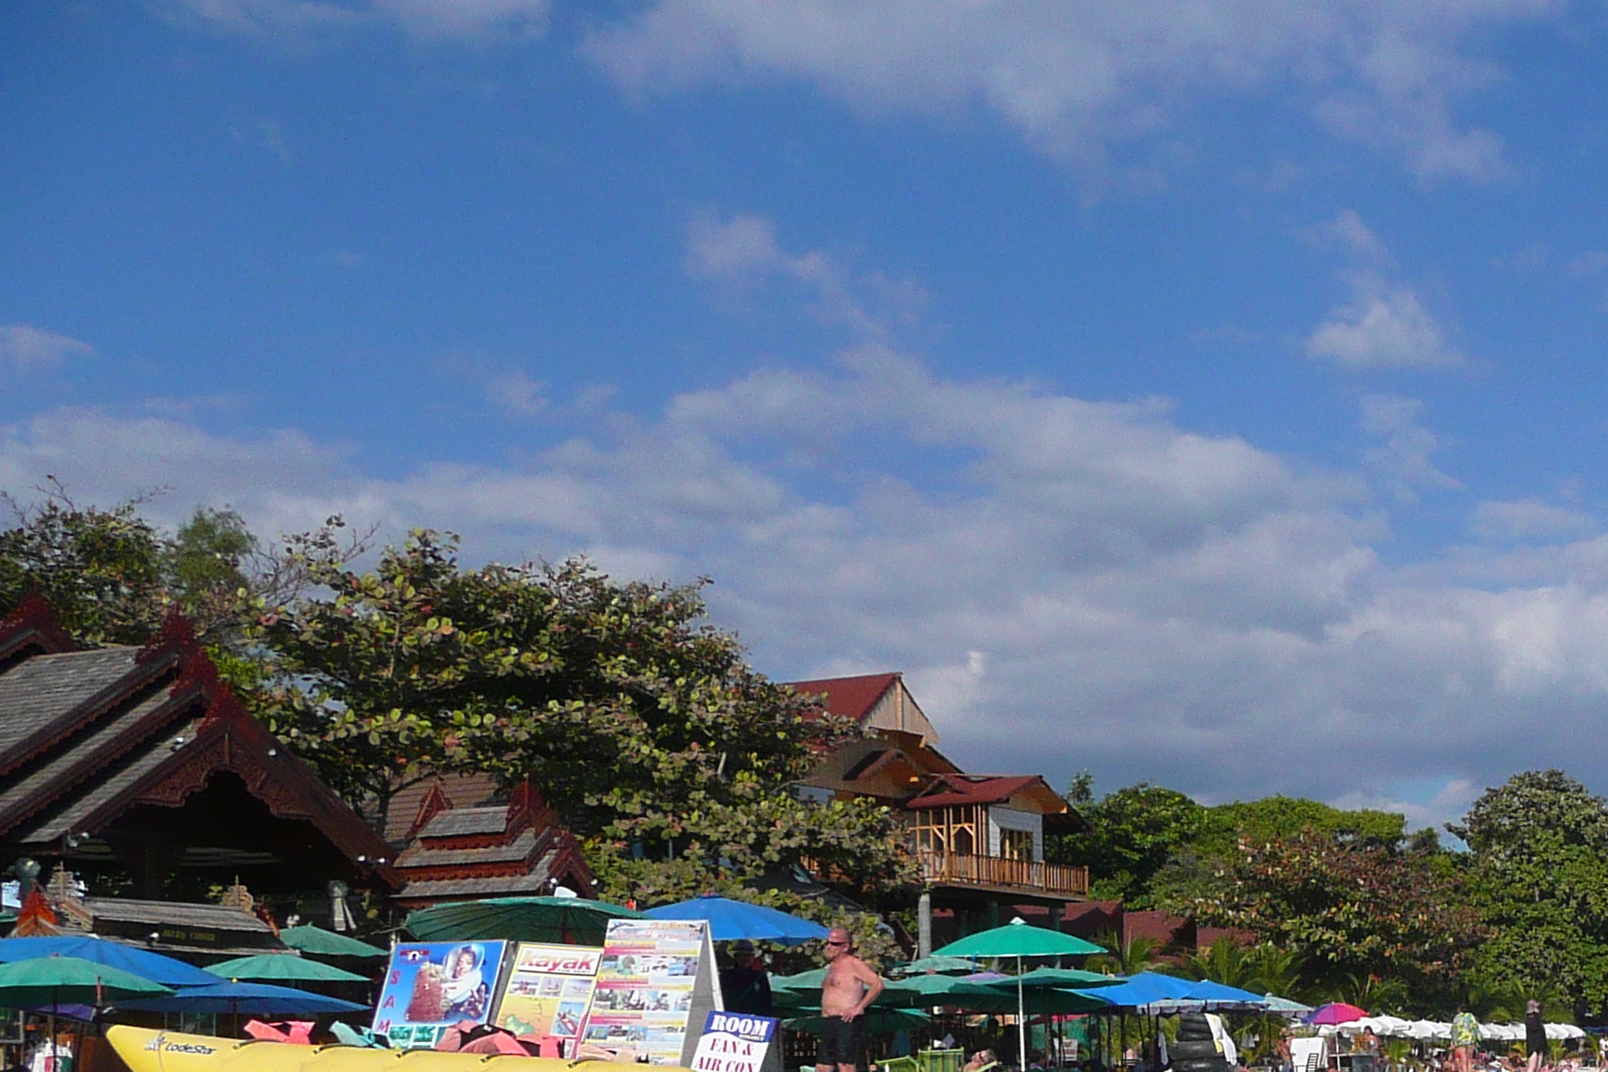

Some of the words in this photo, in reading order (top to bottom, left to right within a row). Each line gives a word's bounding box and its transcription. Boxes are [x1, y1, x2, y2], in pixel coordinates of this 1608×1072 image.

[520, 950, 597, 972] kayak
[710, 1014, 770, 1036] ROOM
[710, 1038, 738, 1055] FAN
[742, 1043, 754, 1057] &
[694, 1056, 722, 1072] AIR
